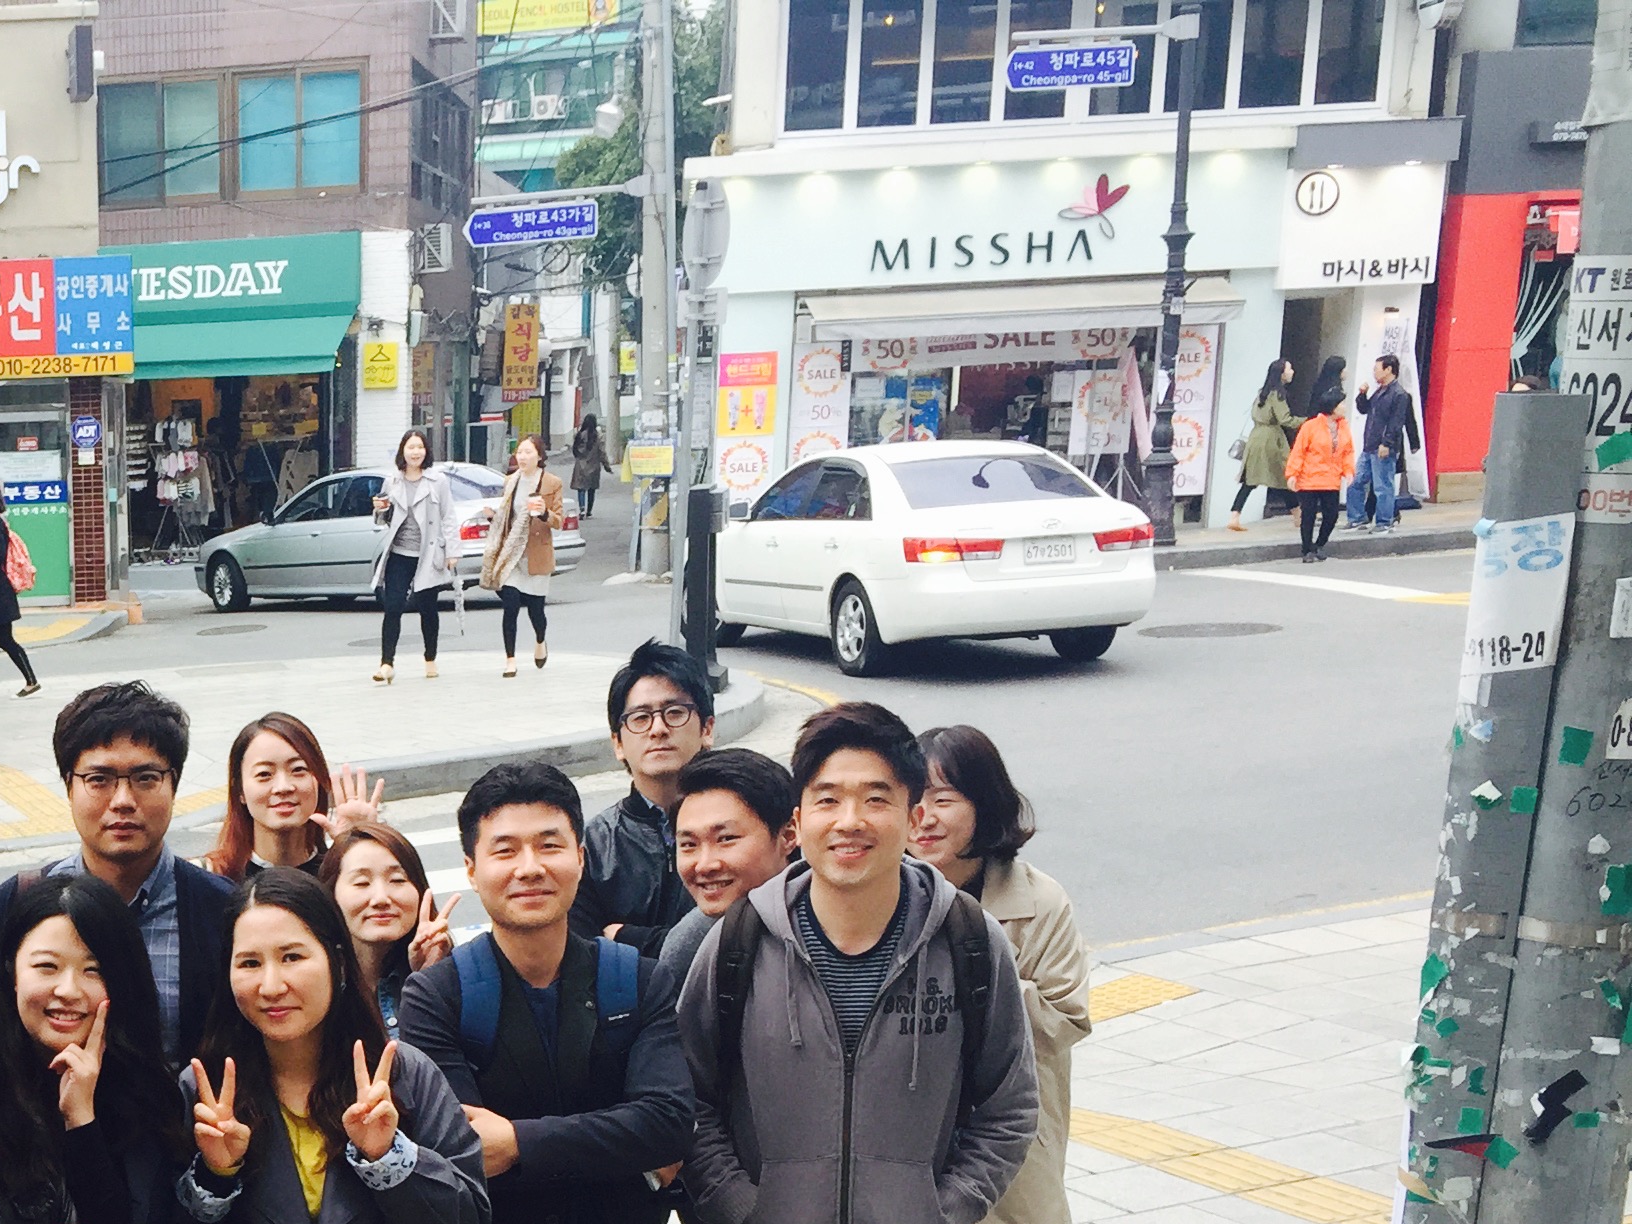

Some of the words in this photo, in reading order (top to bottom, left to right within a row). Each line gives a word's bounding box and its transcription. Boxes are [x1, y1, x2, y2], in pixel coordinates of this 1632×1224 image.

[1049, 48, 1131, 71] 청파로45길
[1021, 73, 1095, 87] Cheongpa-ro
[1096, 69, 1130, 83] 45-gil
[511, 204, 594, 228] 청파로43가길
[492, 228, 554, 242] Cheongpa-ro
[554, 223, 594, 238] 43ga-gil
[870, 228, 1093, 272] MISSHA
[1321, 255, 1431, 283] 마시&바시
[56, 272, 129, 301] 공인중개사
[132, 259, 289, 301] ESDAY
[1177, 352, 1201, 364] ALE
[807, 368, 837, 381] SALE
[75, 424, 97, 439] ADT
[729, 461, 759, 474] SALE
